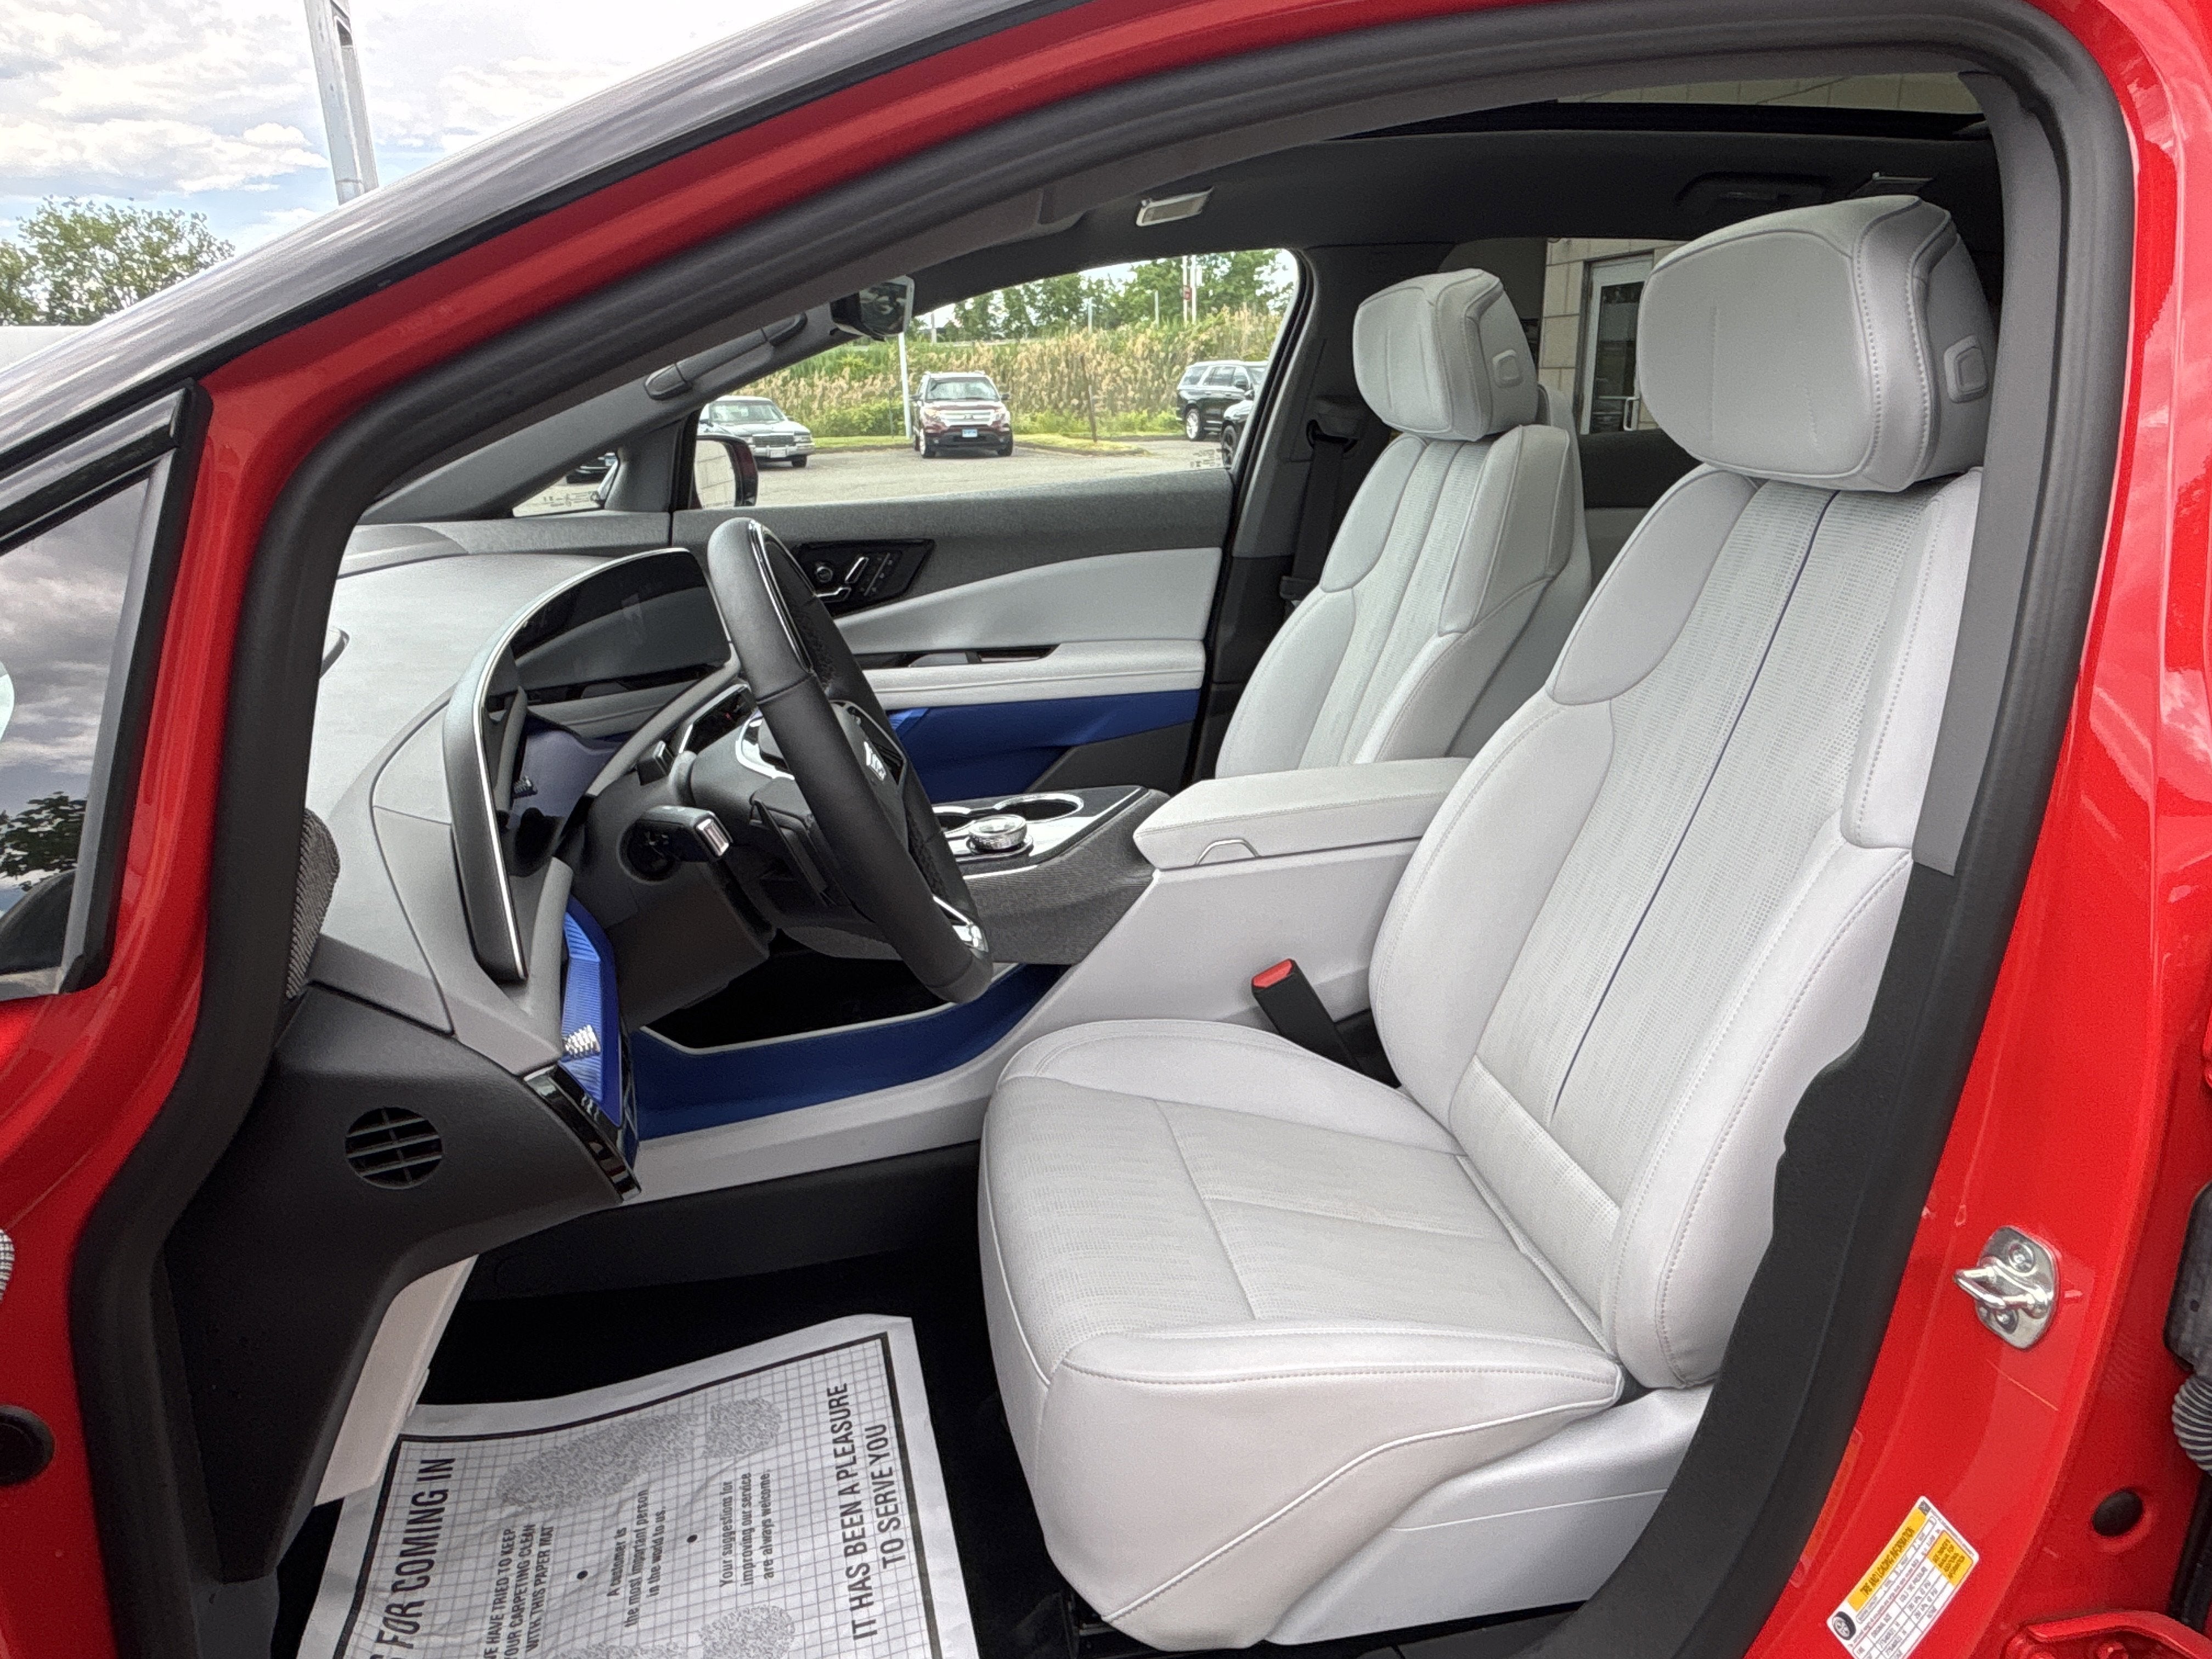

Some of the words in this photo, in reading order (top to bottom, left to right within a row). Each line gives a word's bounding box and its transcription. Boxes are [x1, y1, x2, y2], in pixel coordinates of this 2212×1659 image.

[826, 1383, 858, 1481] PLEASURE
[865, 1424, 890, 1465] YOU
[416, 1458, 455, 1481] IN
[720, 1481, 732, 1495] for
[740, 1473, 752, 1508] service
[838, 1482, 861, 1495] A
[870, 1469, 901, 1532] SERVE
[636, 1489, 648, 1525] person
[655, 1506, 665, 1522] us.
[742, 1510, 752, 1526] our
[518, 1524, 535, 1557] CLEAN
[539, 1526, 554, 1546] MAT
[614, 1528, 627, 1538] is
[652, 1525, 664, 1537] to
[720, 1496, 736, 1555] suggestions
[759, 1519, 774, 1555] always
[840, 1500, 867, 1557] BEEN
[391, 1489, 449, 1593] COMING
[500, 1529, 516, 1556] KEEP
[631, 1528, 646, 1575] important
[651, 1537, 663, 1564] world
[881, 1538, 906, 1568] TO
[498, 1558, 512, 1575] TO
[534, 1550, 550, 1587] PAPER
[610, 1541, 626, 1586] customer
[740, 1528, 755, 1587] improving
[763, 1560, 774, 1579] are
[647, 1565, 661, 1584] the
[719, 1560, 733, 1587] Your
[846, 1563, 874, 1611] HAS
[492, 1577, 509, 1612] TRIED
[509, 1560, 530, 1627] CARPETING
[529, 1588, 545, 1617] THIS
[606, 1588, 620, 1596] A
[629, 1577, 641, 1605] most
[646, 1585, 660, 1598] in
[374, 1600, 425, 1649] FOR
[486, 1614, 504, 1644] HAVE
[624, 1608, 639, 1627] the
[851, 1620, 877, 1639] IT
[525, 1618, 541, 1653] WITH
